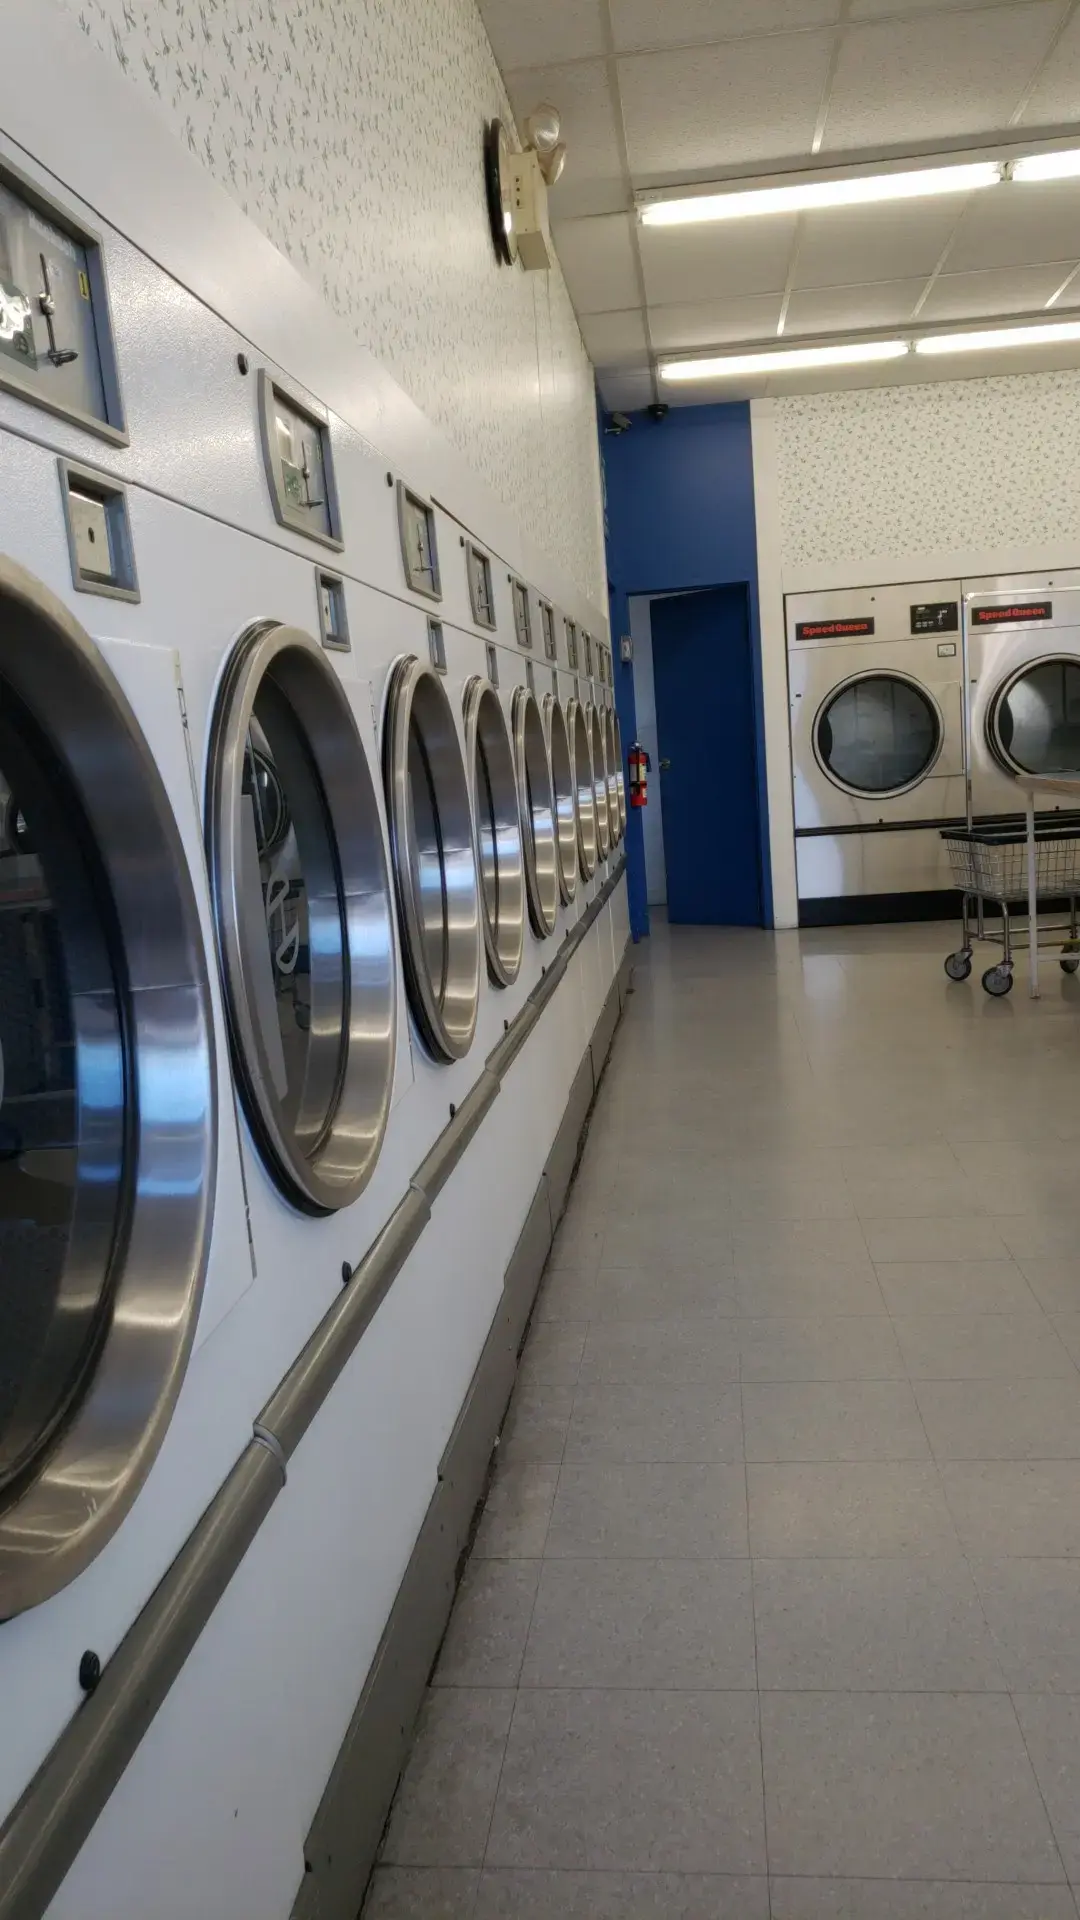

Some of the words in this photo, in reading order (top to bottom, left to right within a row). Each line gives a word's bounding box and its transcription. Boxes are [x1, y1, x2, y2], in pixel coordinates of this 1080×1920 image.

[979, 608, 1011, 620] Speed
[1012, 608, 1046, 616] Queen
[803, 624, 834, 636] Speed
[835, 623, 868, 632] Queen
